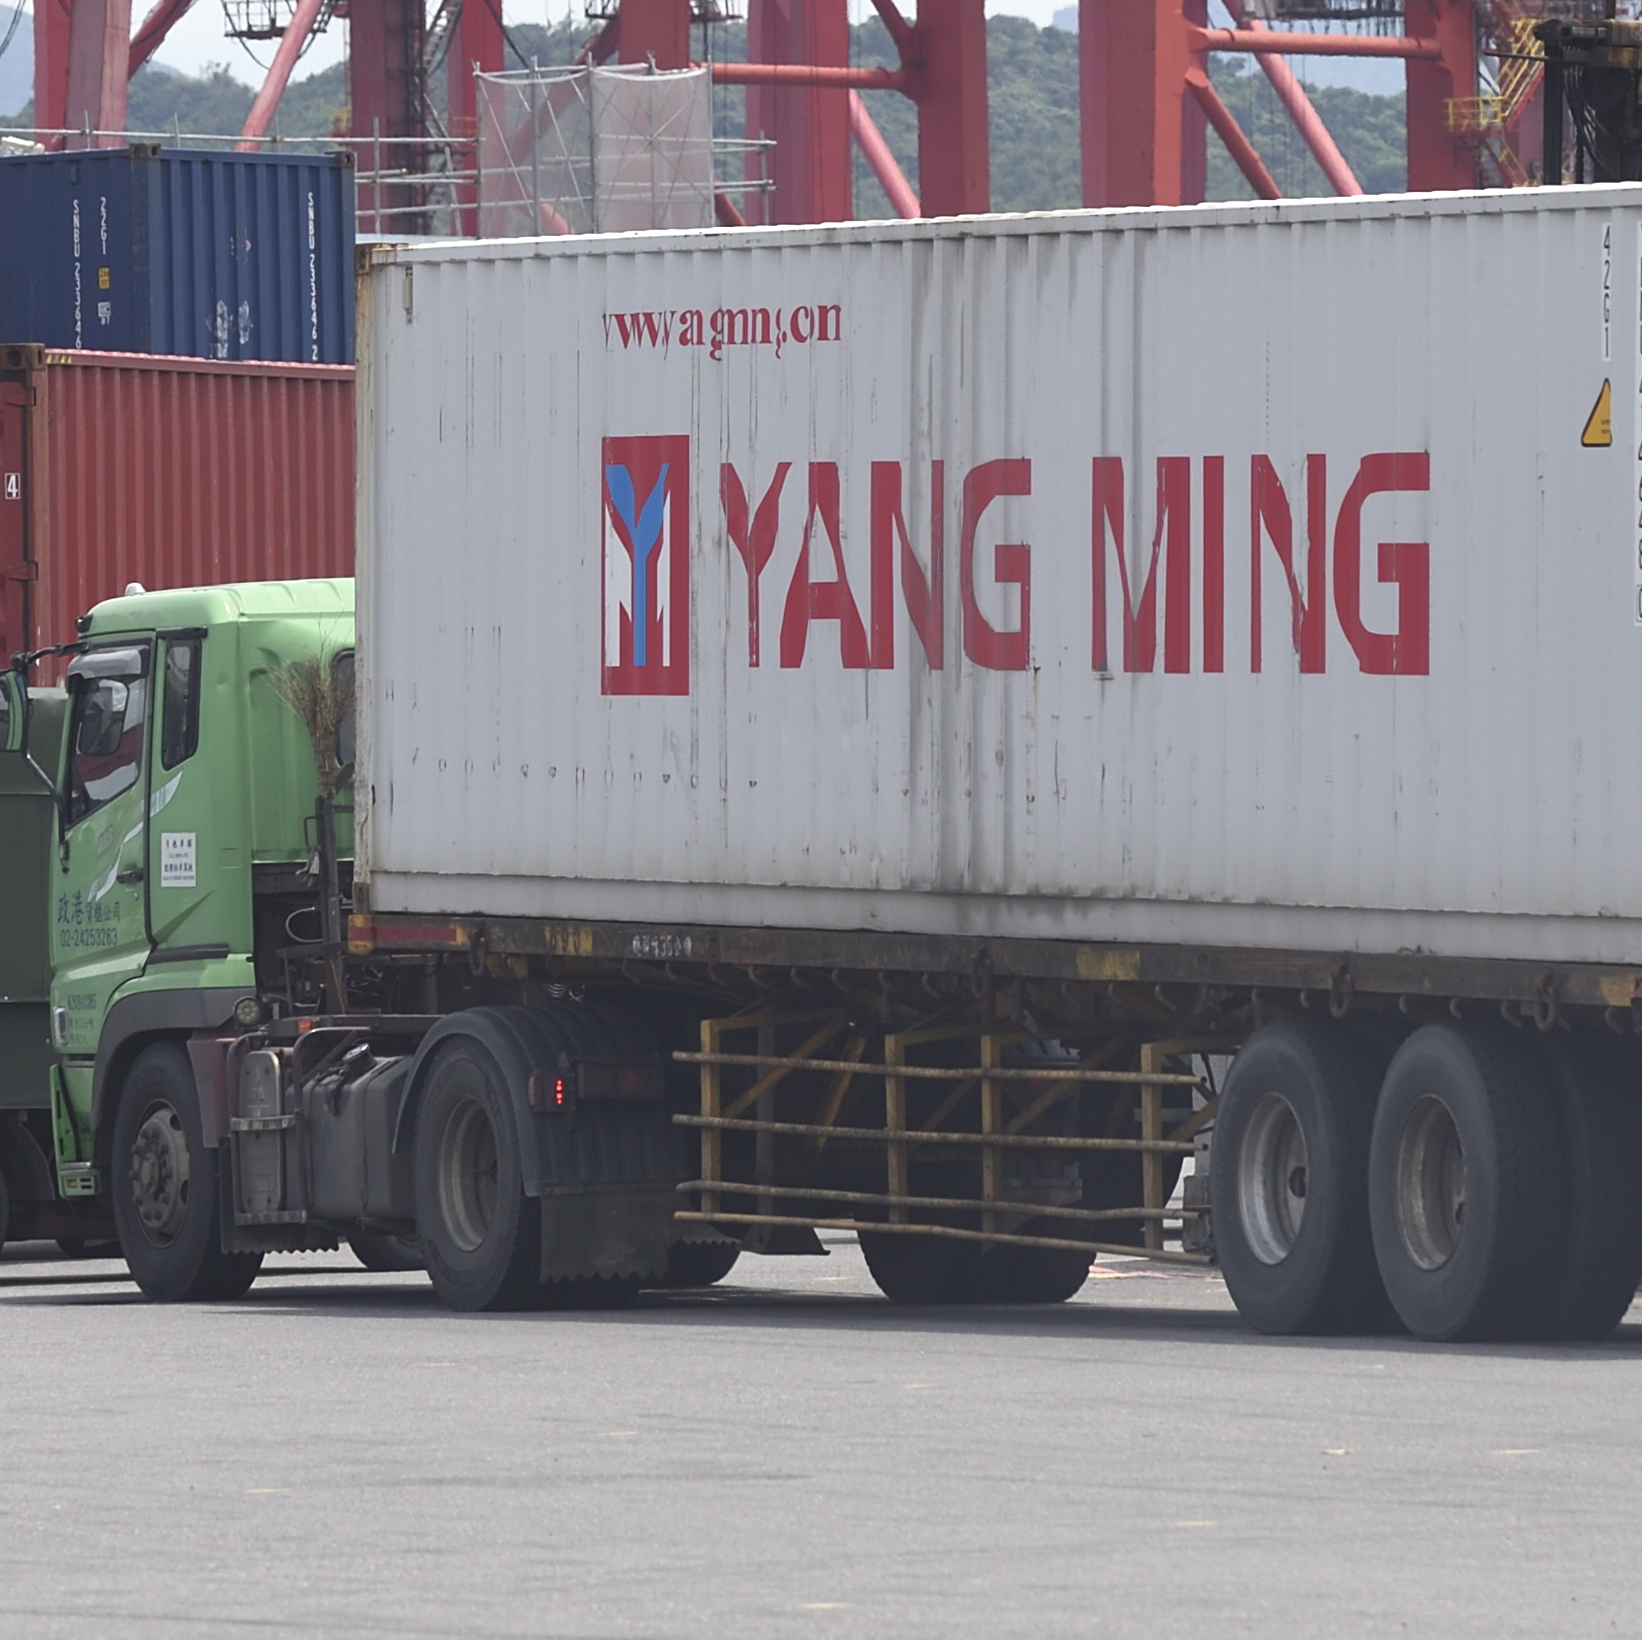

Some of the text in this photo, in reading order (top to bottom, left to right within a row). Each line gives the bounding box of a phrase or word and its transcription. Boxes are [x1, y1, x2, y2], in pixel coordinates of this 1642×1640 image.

[73, 199, 83, 349] SNBU 233646
[308, 192, 319, 360] SNBU 233646 2
[1603, 225, 1611, 359] 42G1
[720, 452, 1431, 676] YANG MING
